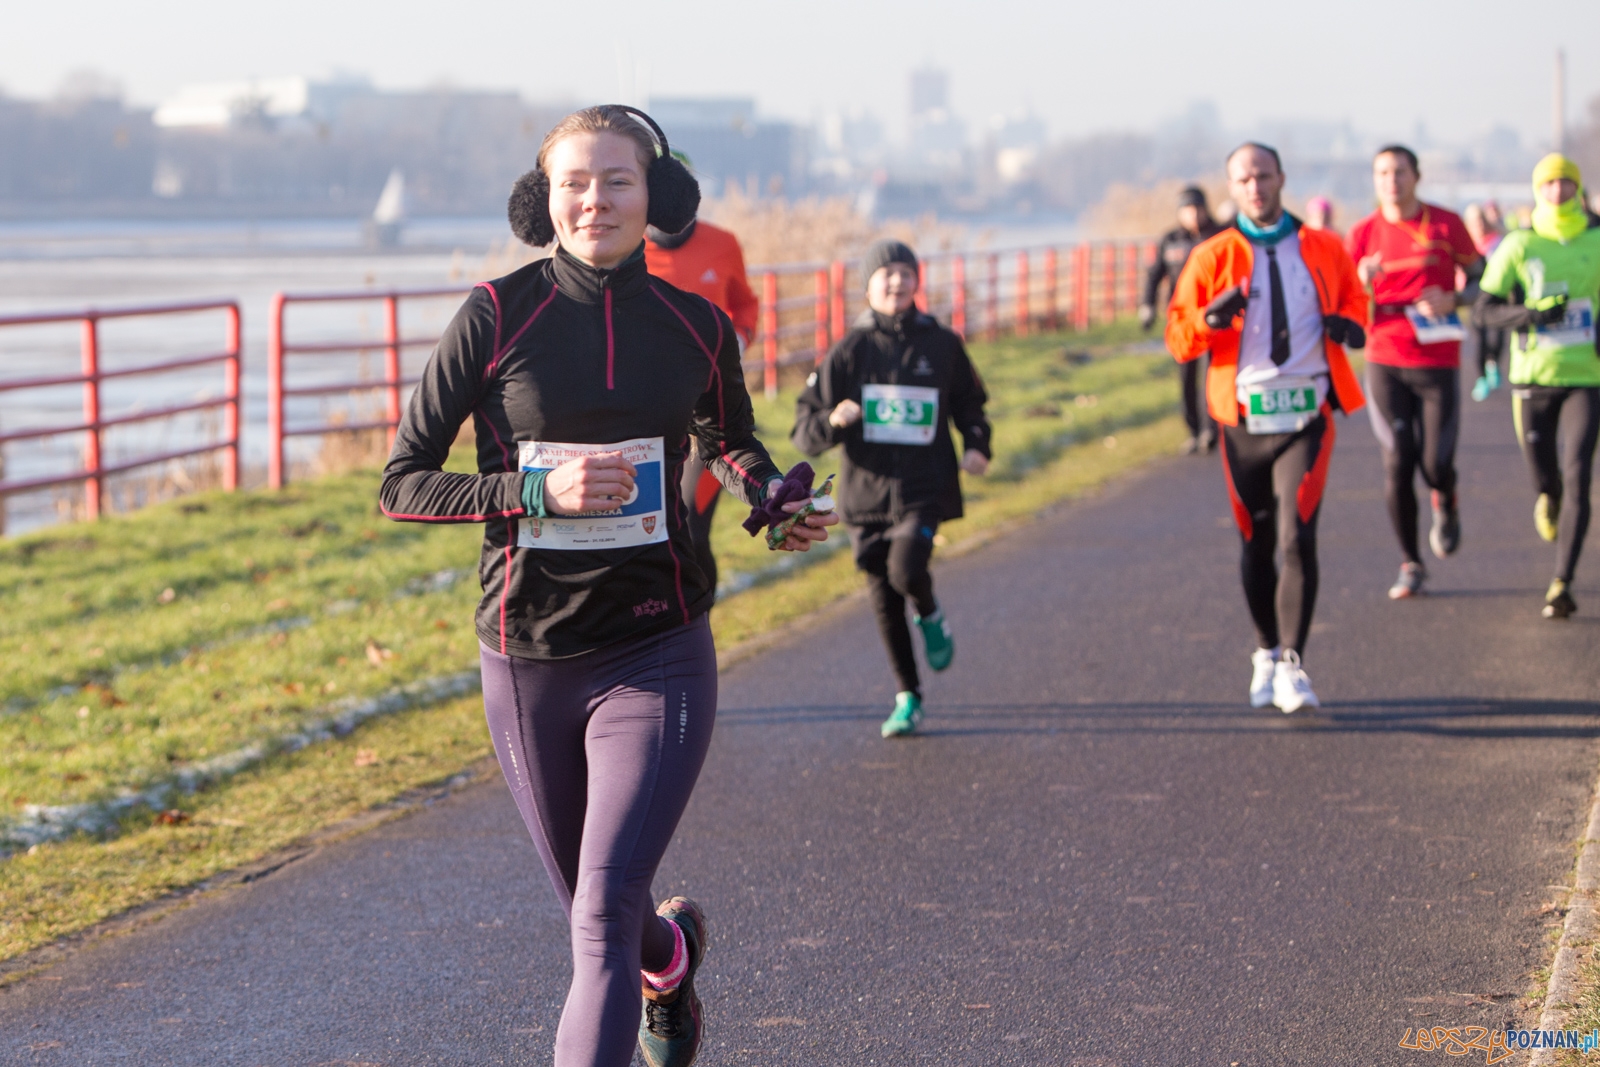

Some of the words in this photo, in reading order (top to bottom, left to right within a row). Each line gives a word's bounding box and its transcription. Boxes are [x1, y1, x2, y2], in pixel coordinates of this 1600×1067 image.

[1262, 388, 1307, 413] 584
[564, 449, 586, 457] BIEG
[541, 458, 555, 466] IM.
